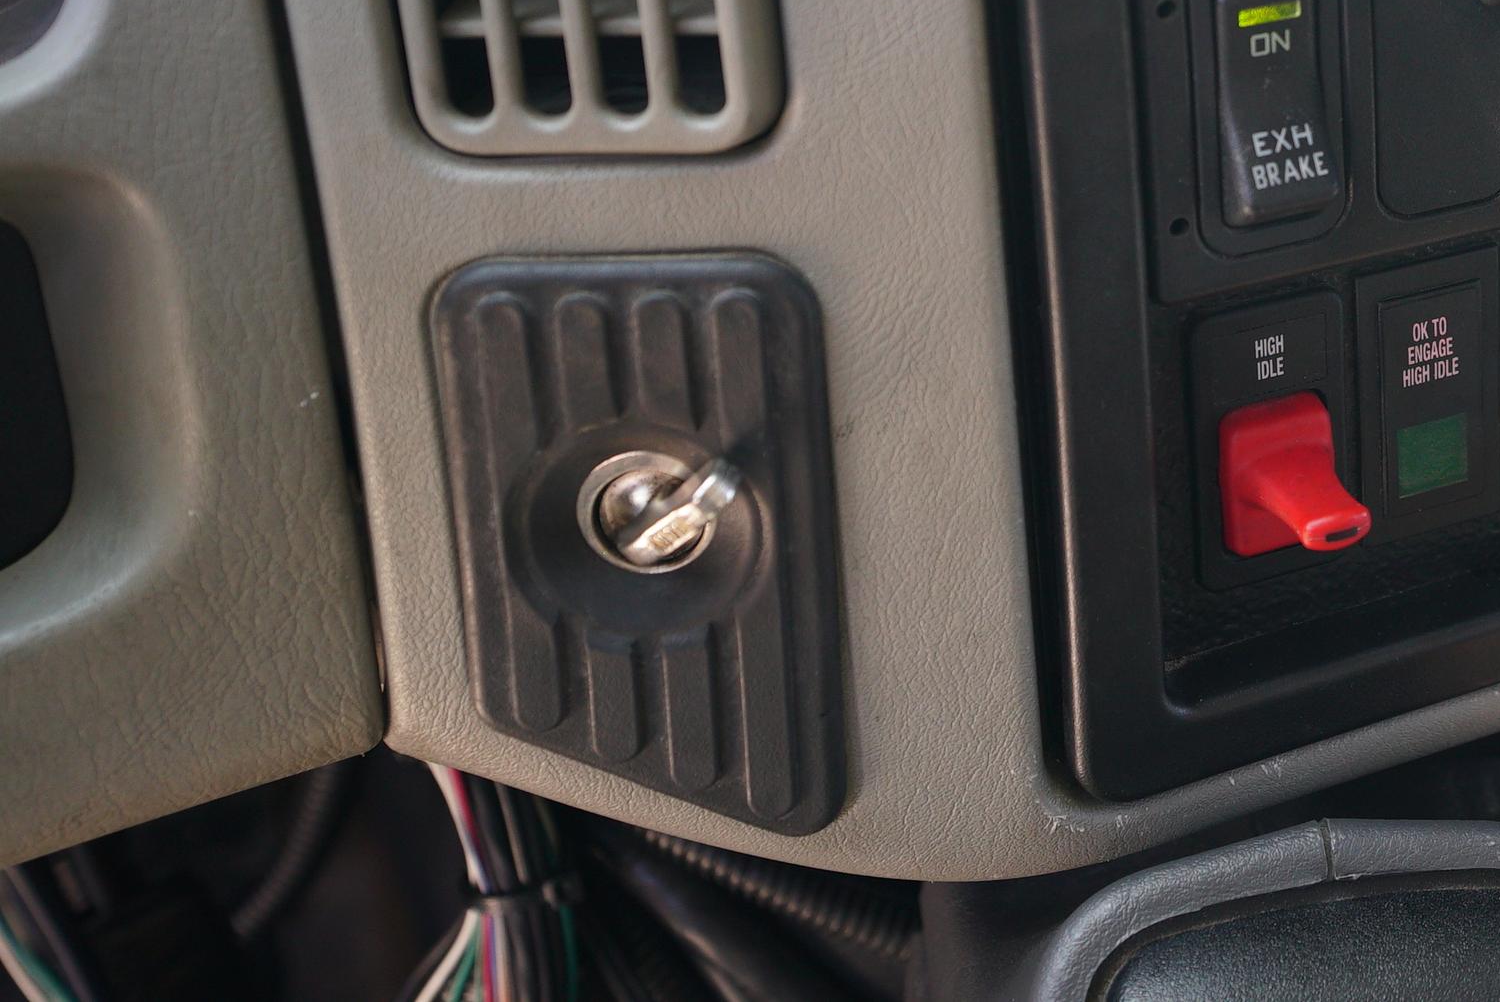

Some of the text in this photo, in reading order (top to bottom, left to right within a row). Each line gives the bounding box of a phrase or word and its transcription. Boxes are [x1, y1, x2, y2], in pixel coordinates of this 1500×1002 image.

[1250, 29, 1291, 57] ON
[1252, 122, 1314, 158] EXH
[1252, 151, 1329, 191] BRAKE
[1412, 316, 1447, 342] OK TO
[1255, 334, 1284, 359] HIGH
[1407, 337, 1454, 365] ENGAGE
[1256, 357, 1285, 381] IDLE
[1402, 357, 1460, 388] HIGH IDLE
